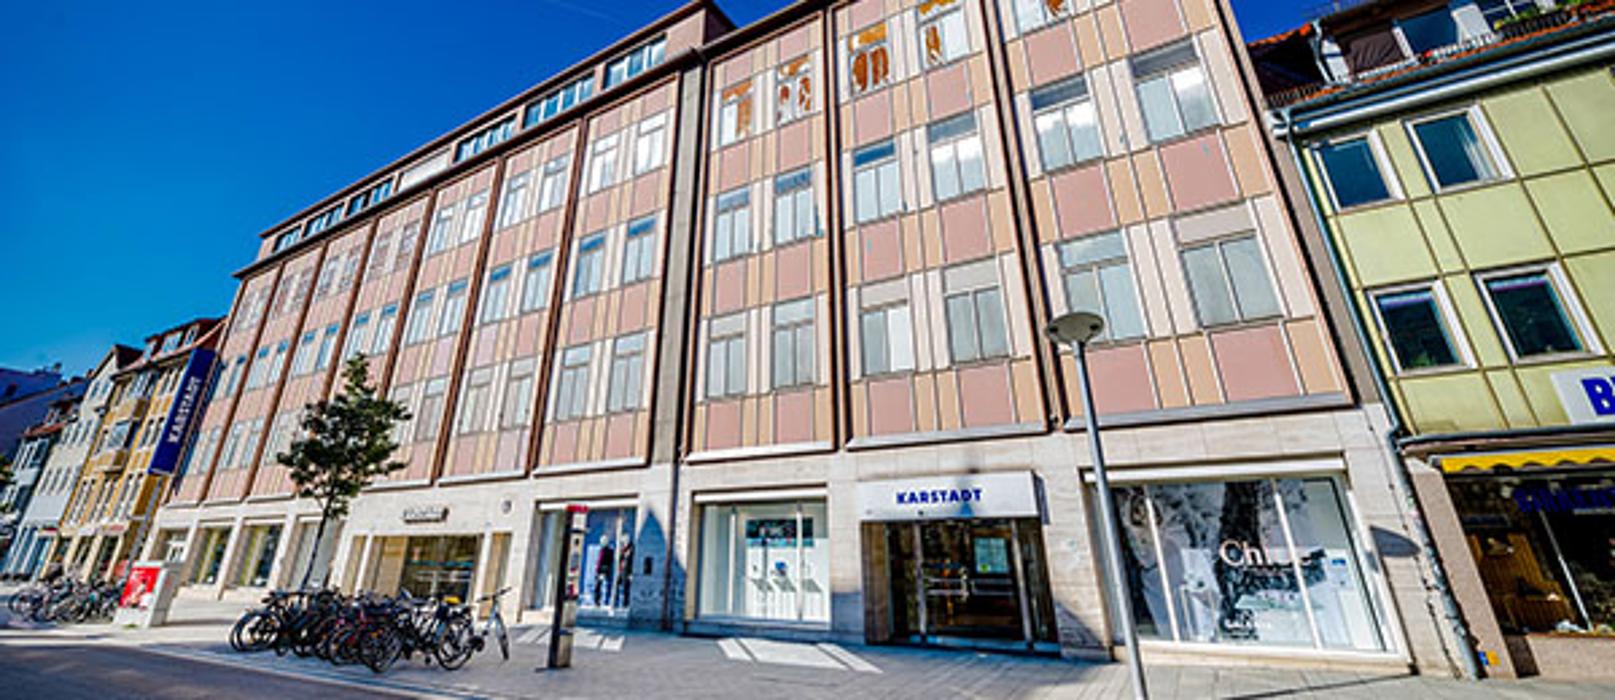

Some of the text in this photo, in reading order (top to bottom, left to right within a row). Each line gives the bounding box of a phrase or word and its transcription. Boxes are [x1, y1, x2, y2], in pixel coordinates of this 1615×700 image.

[166, 376, 202, 442] KARSTADT
[1581, 377, 1615, 416] B
[896, 488, 982, 504] KARSTADT
